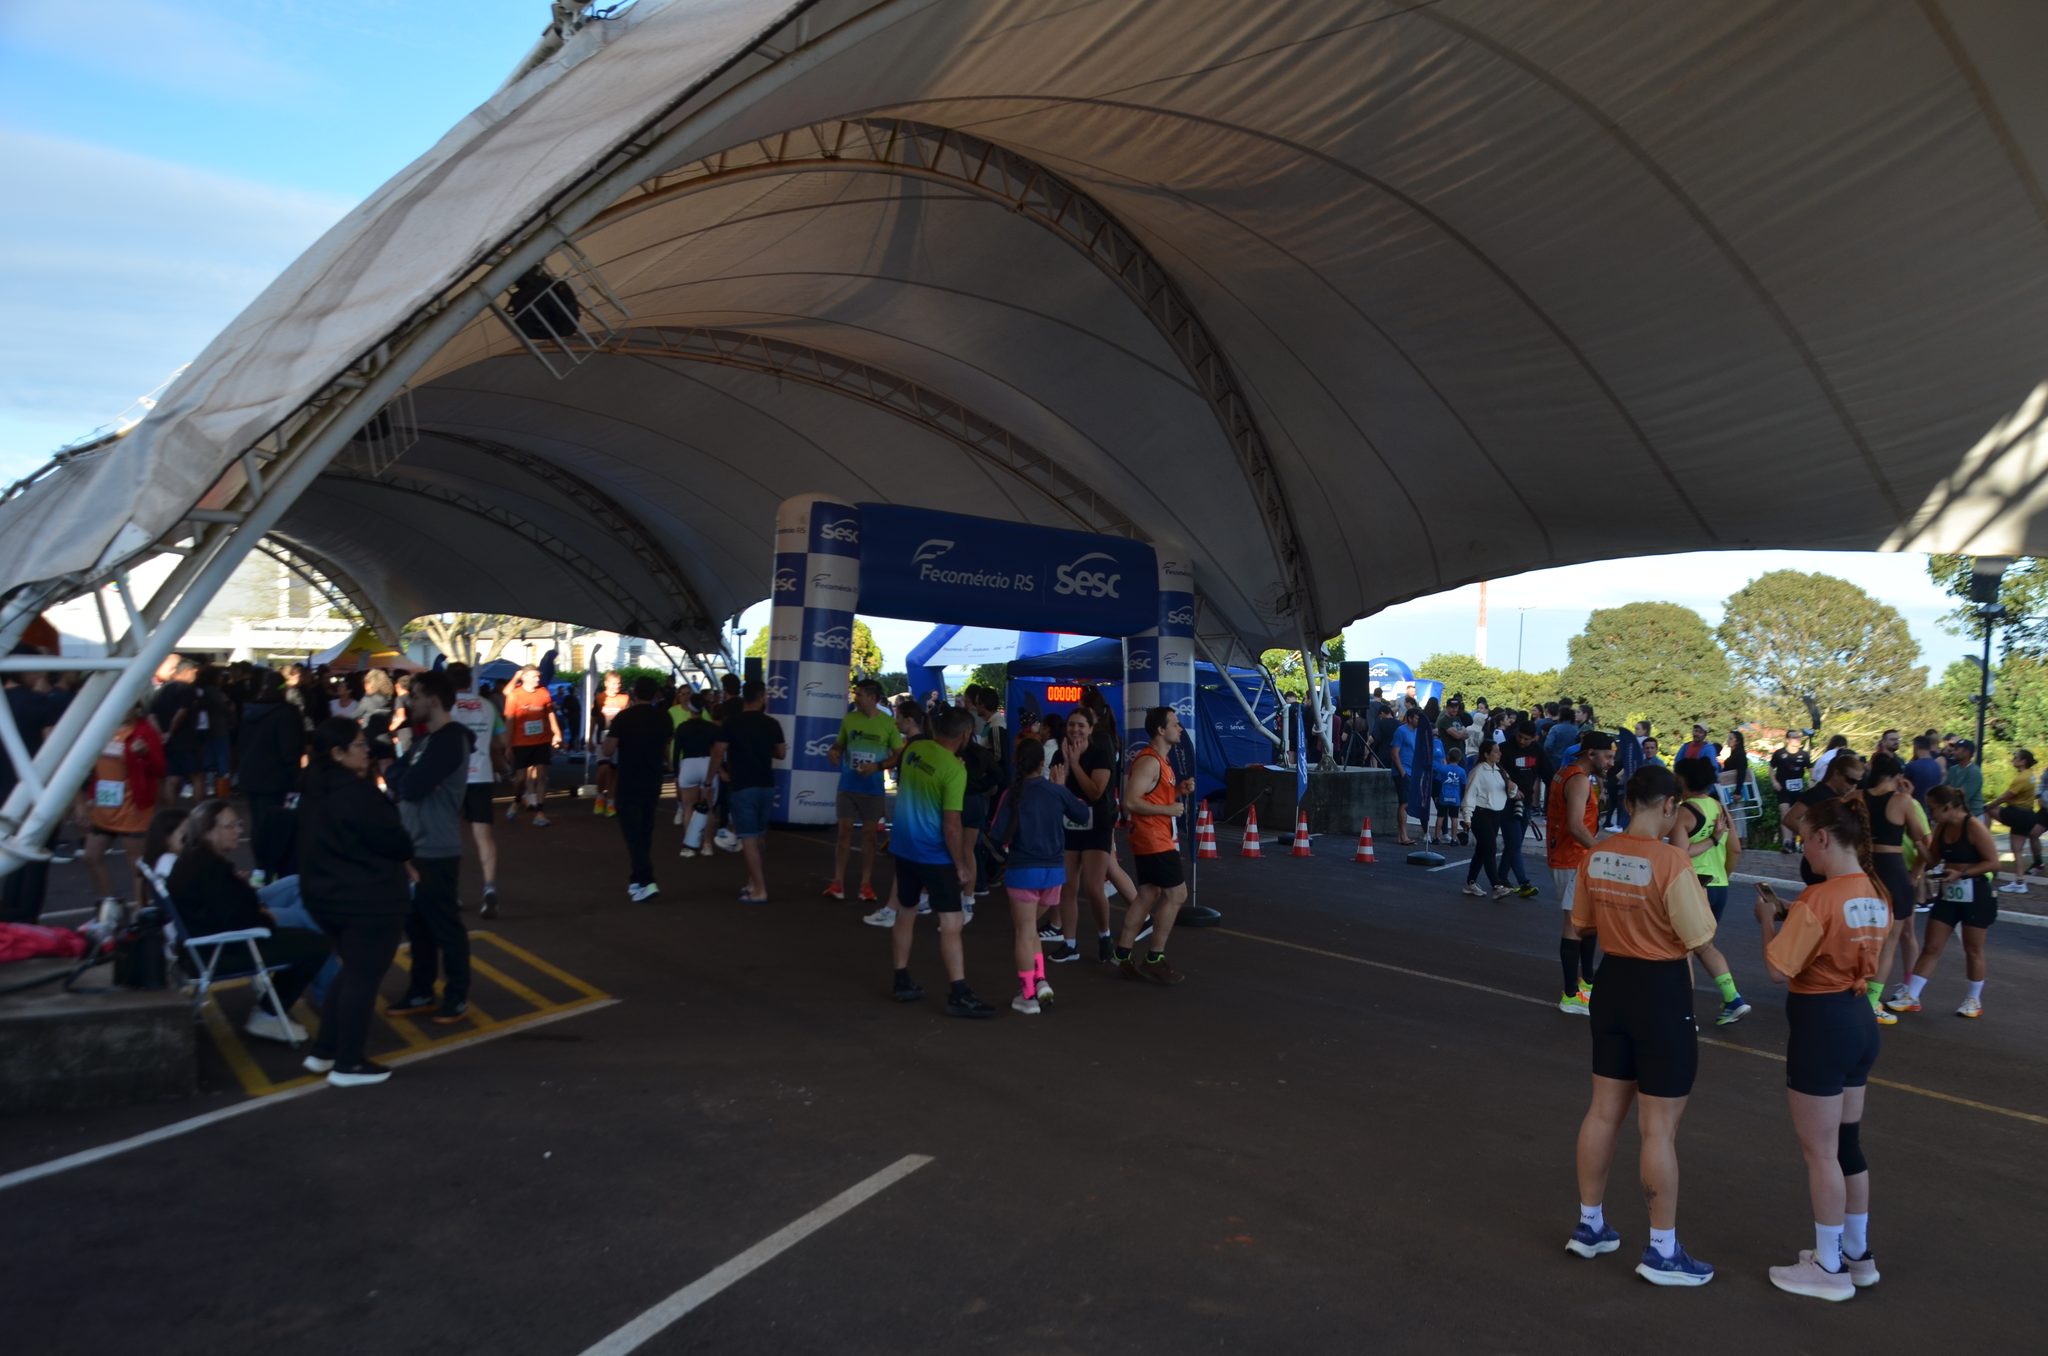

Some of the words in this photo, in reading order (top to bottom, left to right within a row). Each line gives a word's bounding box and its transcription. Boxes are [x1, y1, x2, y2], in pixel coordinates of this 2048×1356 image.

[820, 522, 859, 543] Sesc
[920, 563, 1009, 589] Fecomércio
[1014, 574, 1035, 592] RS
[1053, 560, 1121, 599] Sesc
[1127, 657, 1152, 670] esc
[804, 740, 833, 756] Se
